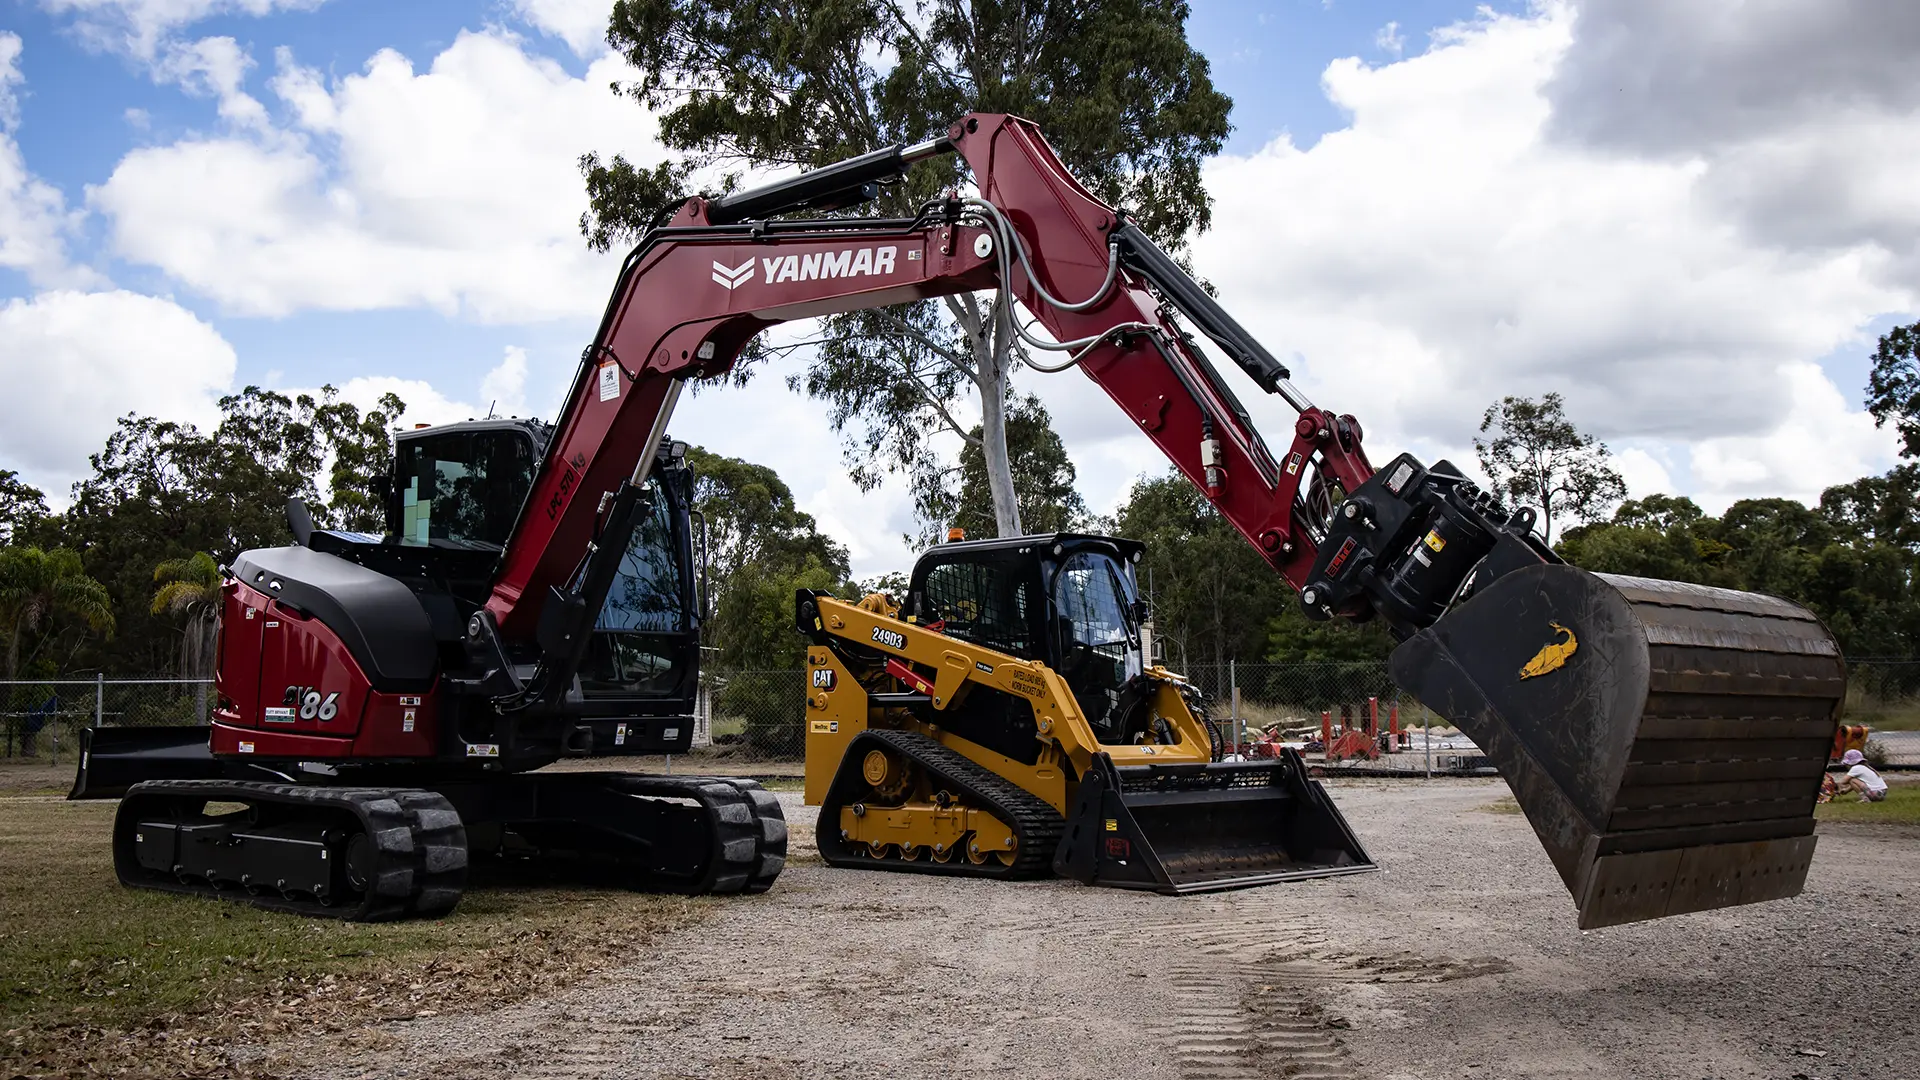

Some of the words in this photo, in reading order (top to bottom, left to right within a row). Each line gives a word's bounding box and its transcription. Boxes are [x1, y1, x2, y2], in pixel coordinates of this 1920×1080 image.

[762, 245, 898, 284] YANMAR
[546, 491, 562, 521] LPC
[560, 468, 574, 496] 570
[1326, 537, 1356, 578] ELITE
[872, 627, 903, 648] 249D3
[813, 669, 833, 687] CAT
